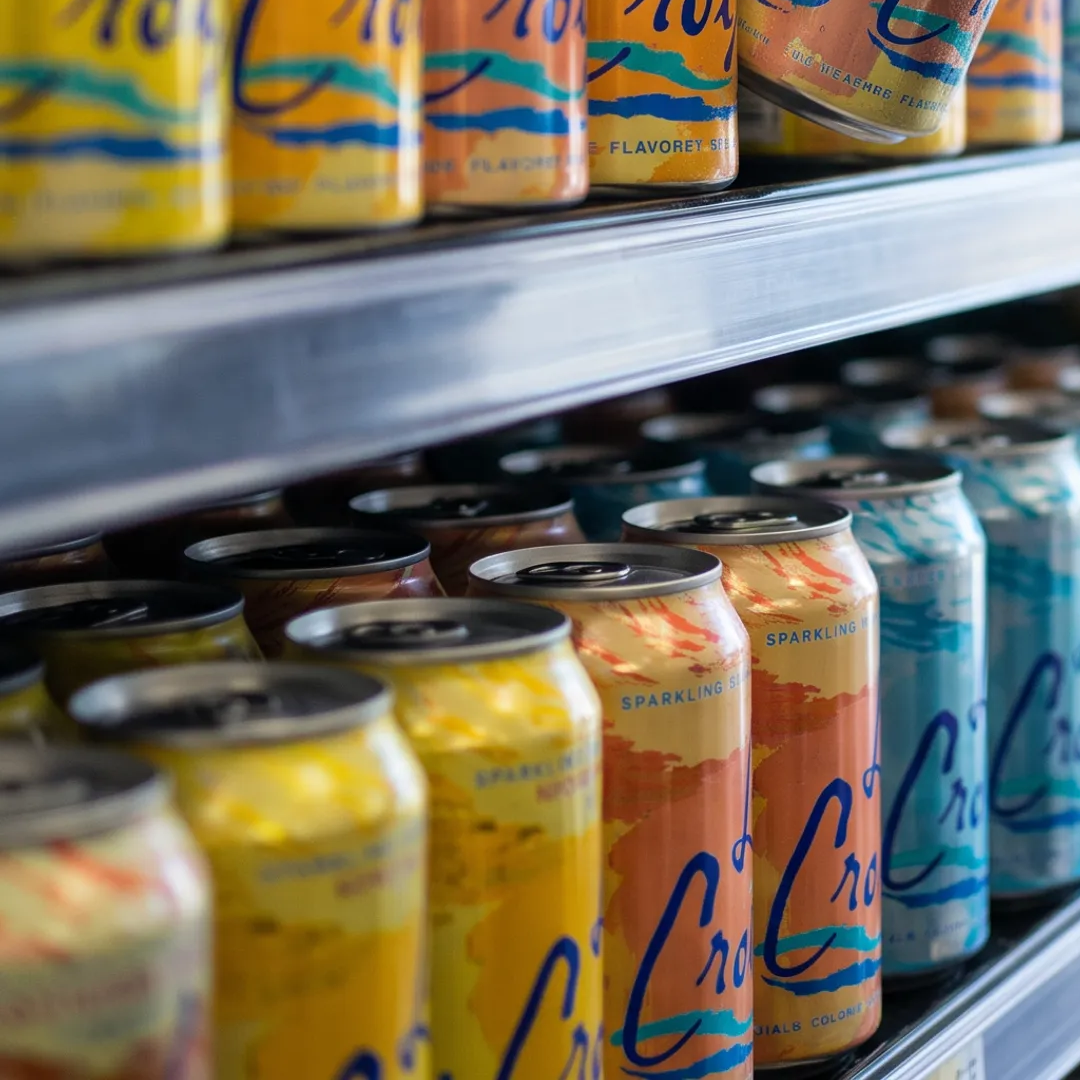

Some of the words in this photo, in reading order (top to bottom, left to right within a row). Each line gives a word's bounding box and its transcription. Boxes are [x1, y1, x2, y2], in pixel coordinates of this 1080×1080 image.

[765, 620, 857, 646] SPARKLING
[621, 681, 724, 712] SPARKLING
[622, 850, 754, 1068] Cro
